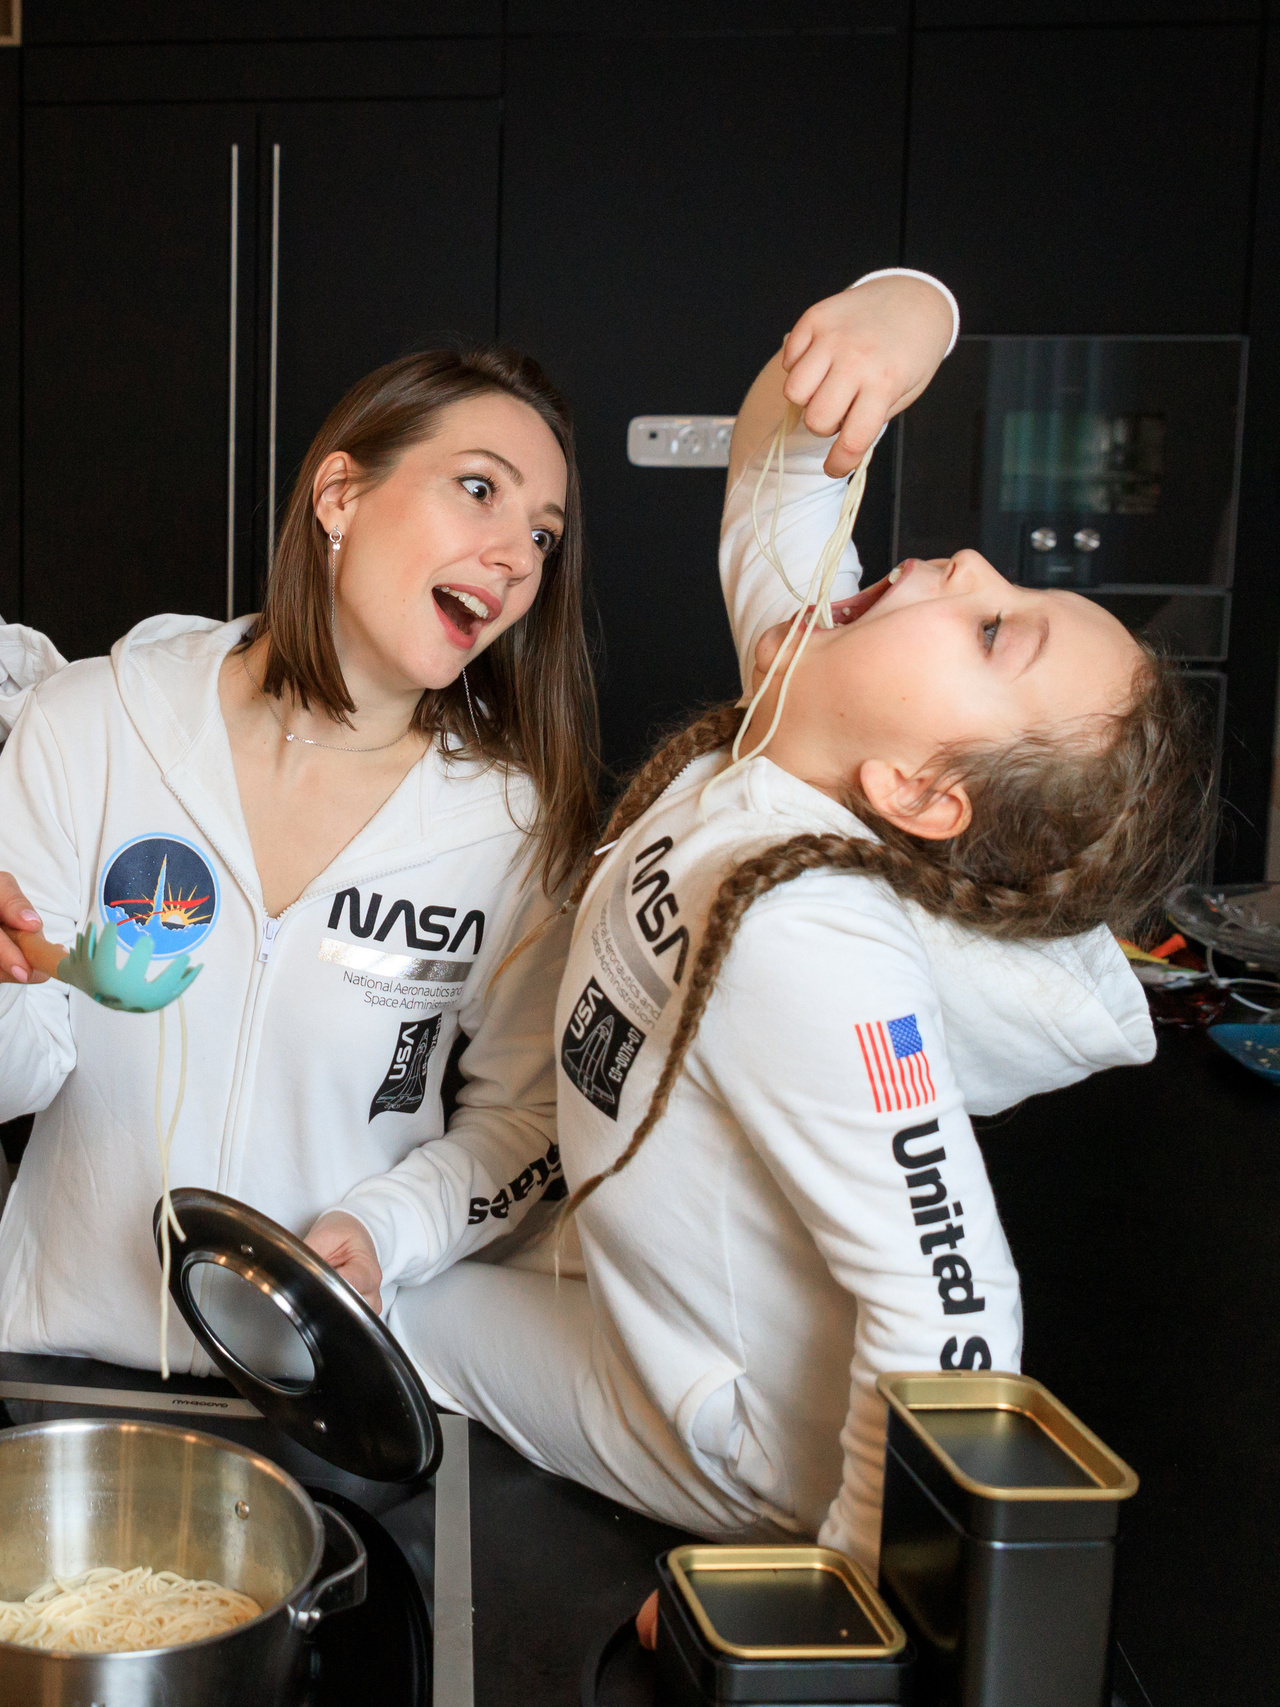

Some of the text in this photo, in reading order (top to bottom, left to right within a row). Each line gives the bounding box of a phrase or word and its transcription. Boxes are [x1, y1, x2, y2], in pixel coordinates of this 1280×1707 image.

[327, 886, 485, 955] NASA
[631, 835, 690, 985] NASA
[343, 970, 394, 993] National
[393, 982, 450, 997] Aeronautics
[363, 990, 399, 1008] Space
[570, 986, 604, 1040] USA
[388, 1023, 419, 1080] USA
[892, 1117, 986, 1315] United
